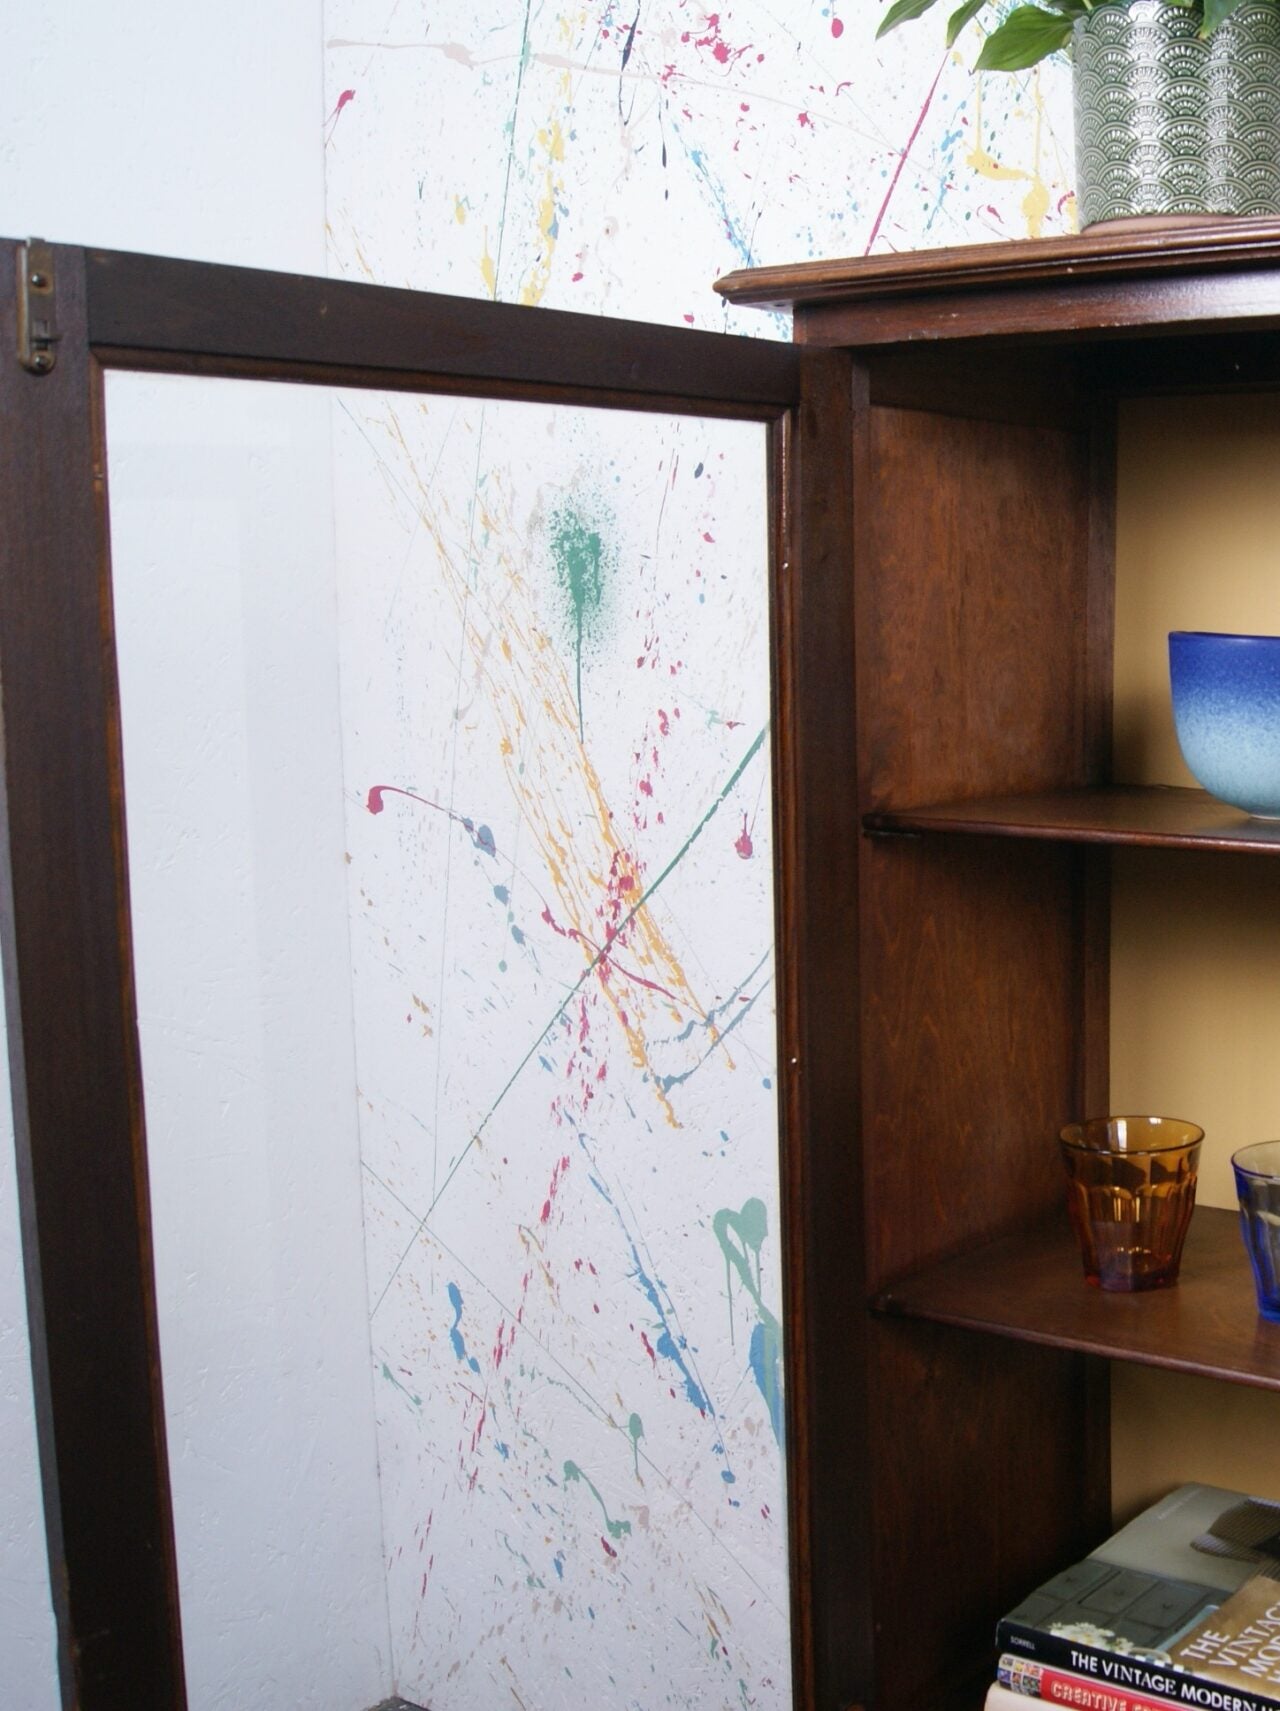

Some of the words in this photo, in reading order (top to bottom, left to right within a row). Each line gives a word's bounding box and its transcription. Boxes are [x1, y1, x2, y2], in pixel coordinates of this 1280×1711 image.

[1180, 1629, 1231, 1660] THE
[1070, 1650, 1099, 1673] THE
[1102, 1659, 1177, 1695] VINTAGE
[1180, 1682, 1257, 1711] MODERN
